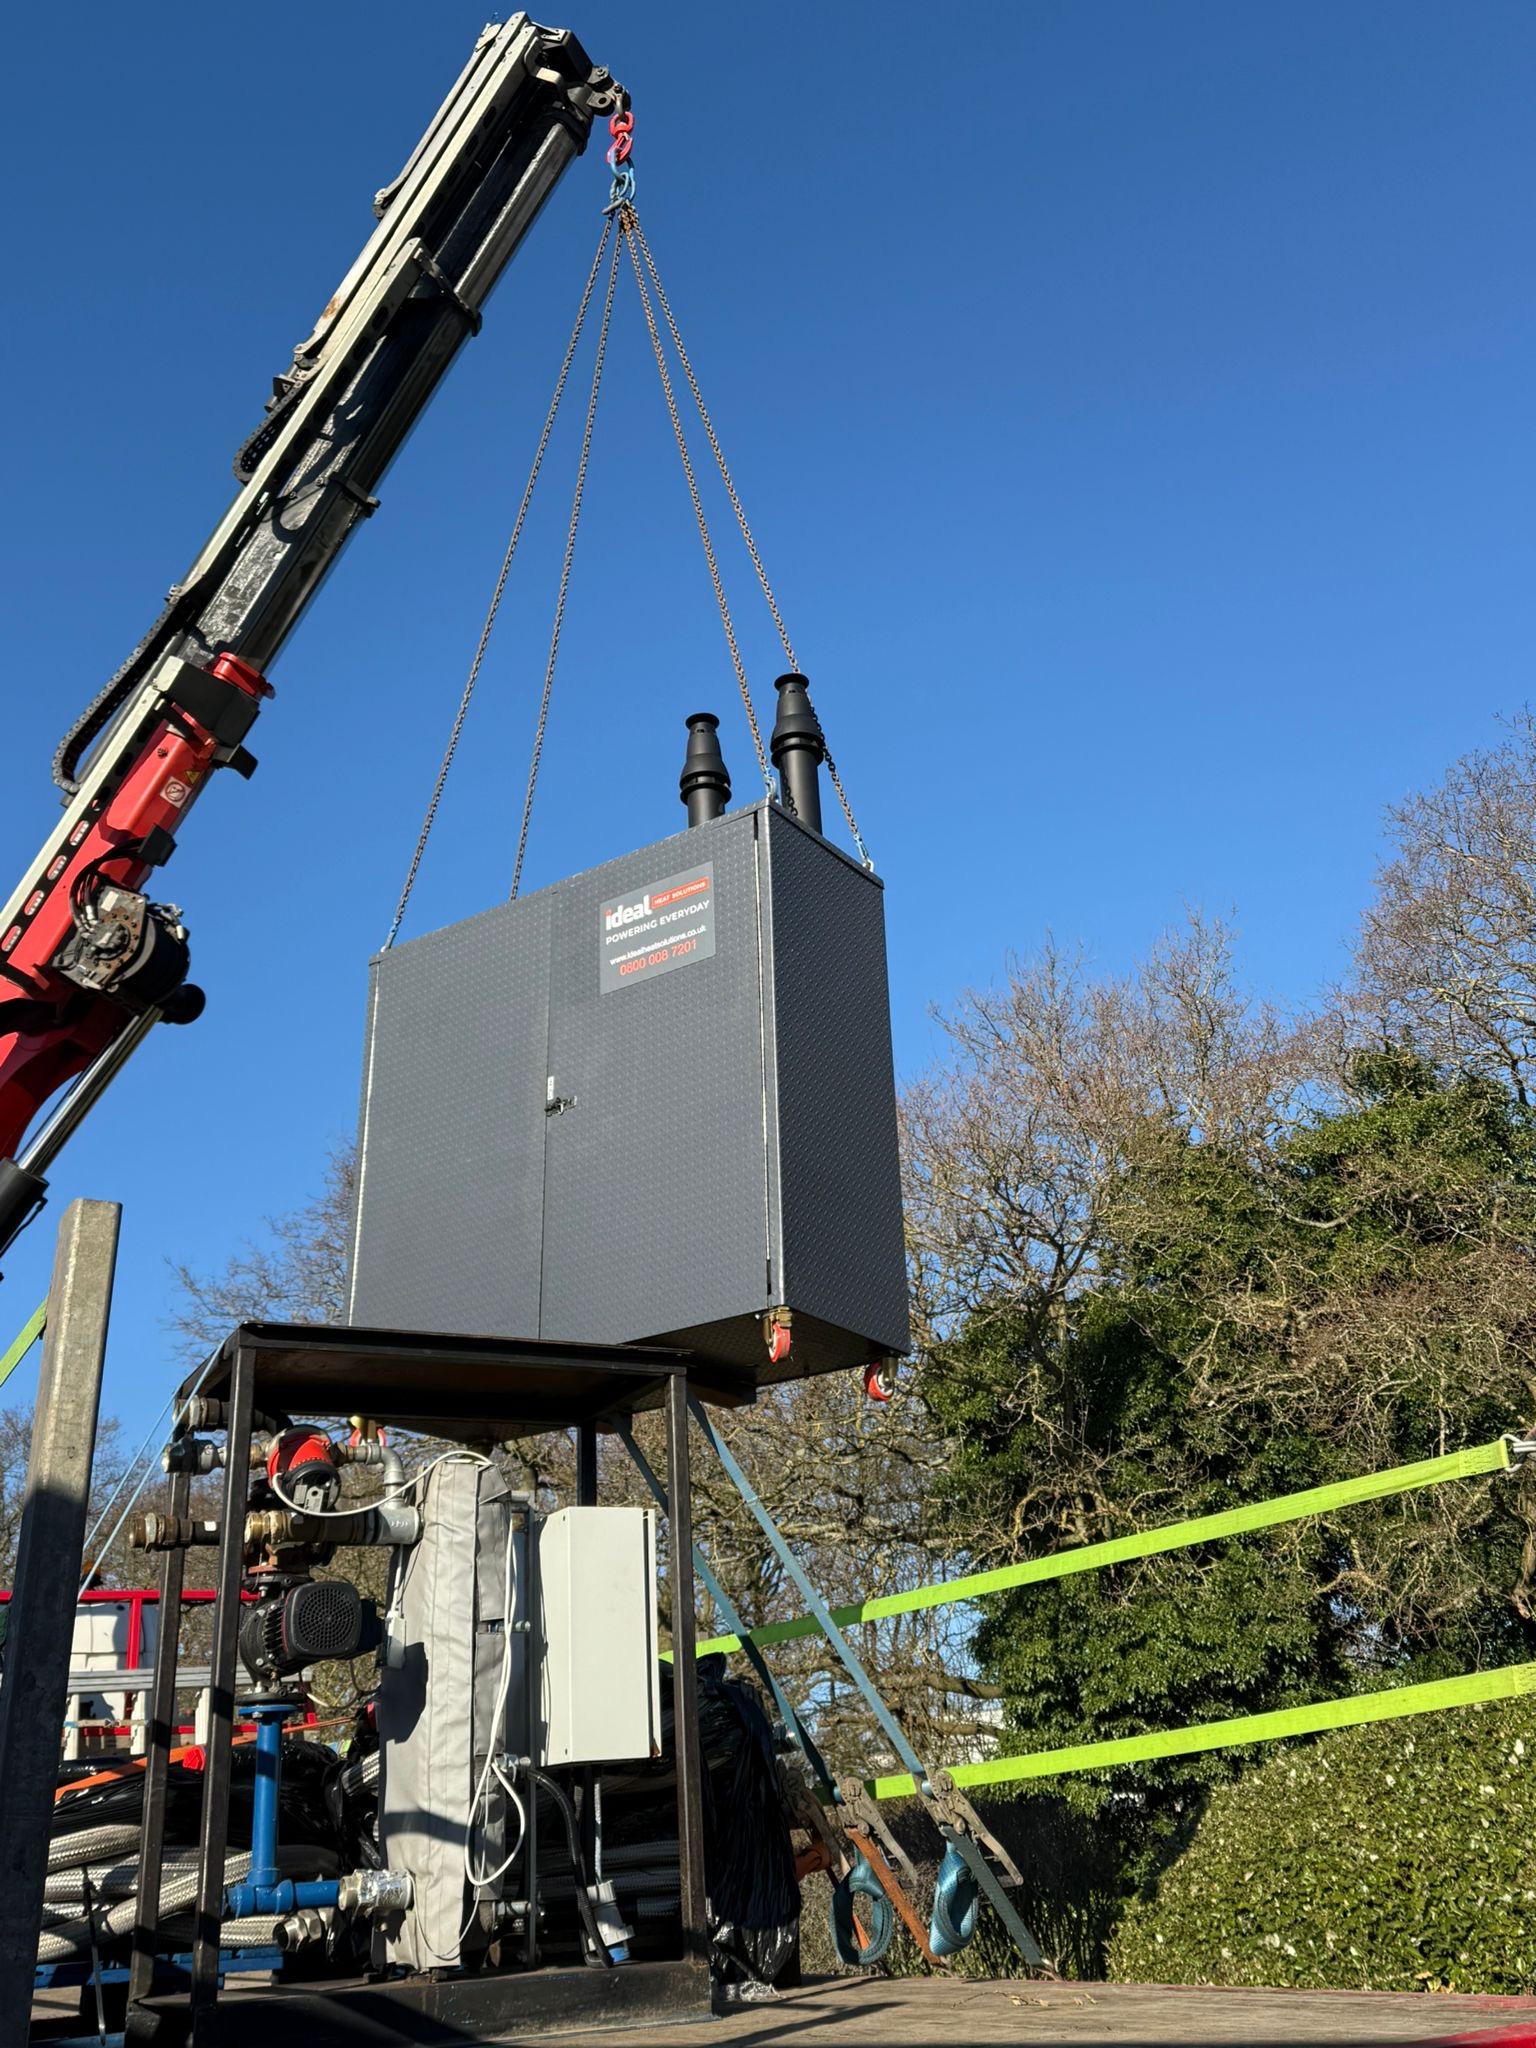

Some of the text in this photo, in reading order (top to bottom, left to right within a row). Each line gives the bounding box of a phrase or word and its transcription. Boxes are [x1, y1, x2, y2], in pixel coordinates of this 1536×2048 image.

[672, 882, 706, 899] SOLUTIONS
[605, 895, 652, 930] ideal
[606, 900, 710, 945] POWERING EVERYDAY
[619, 939, 697, 976] 0800 008 7201
